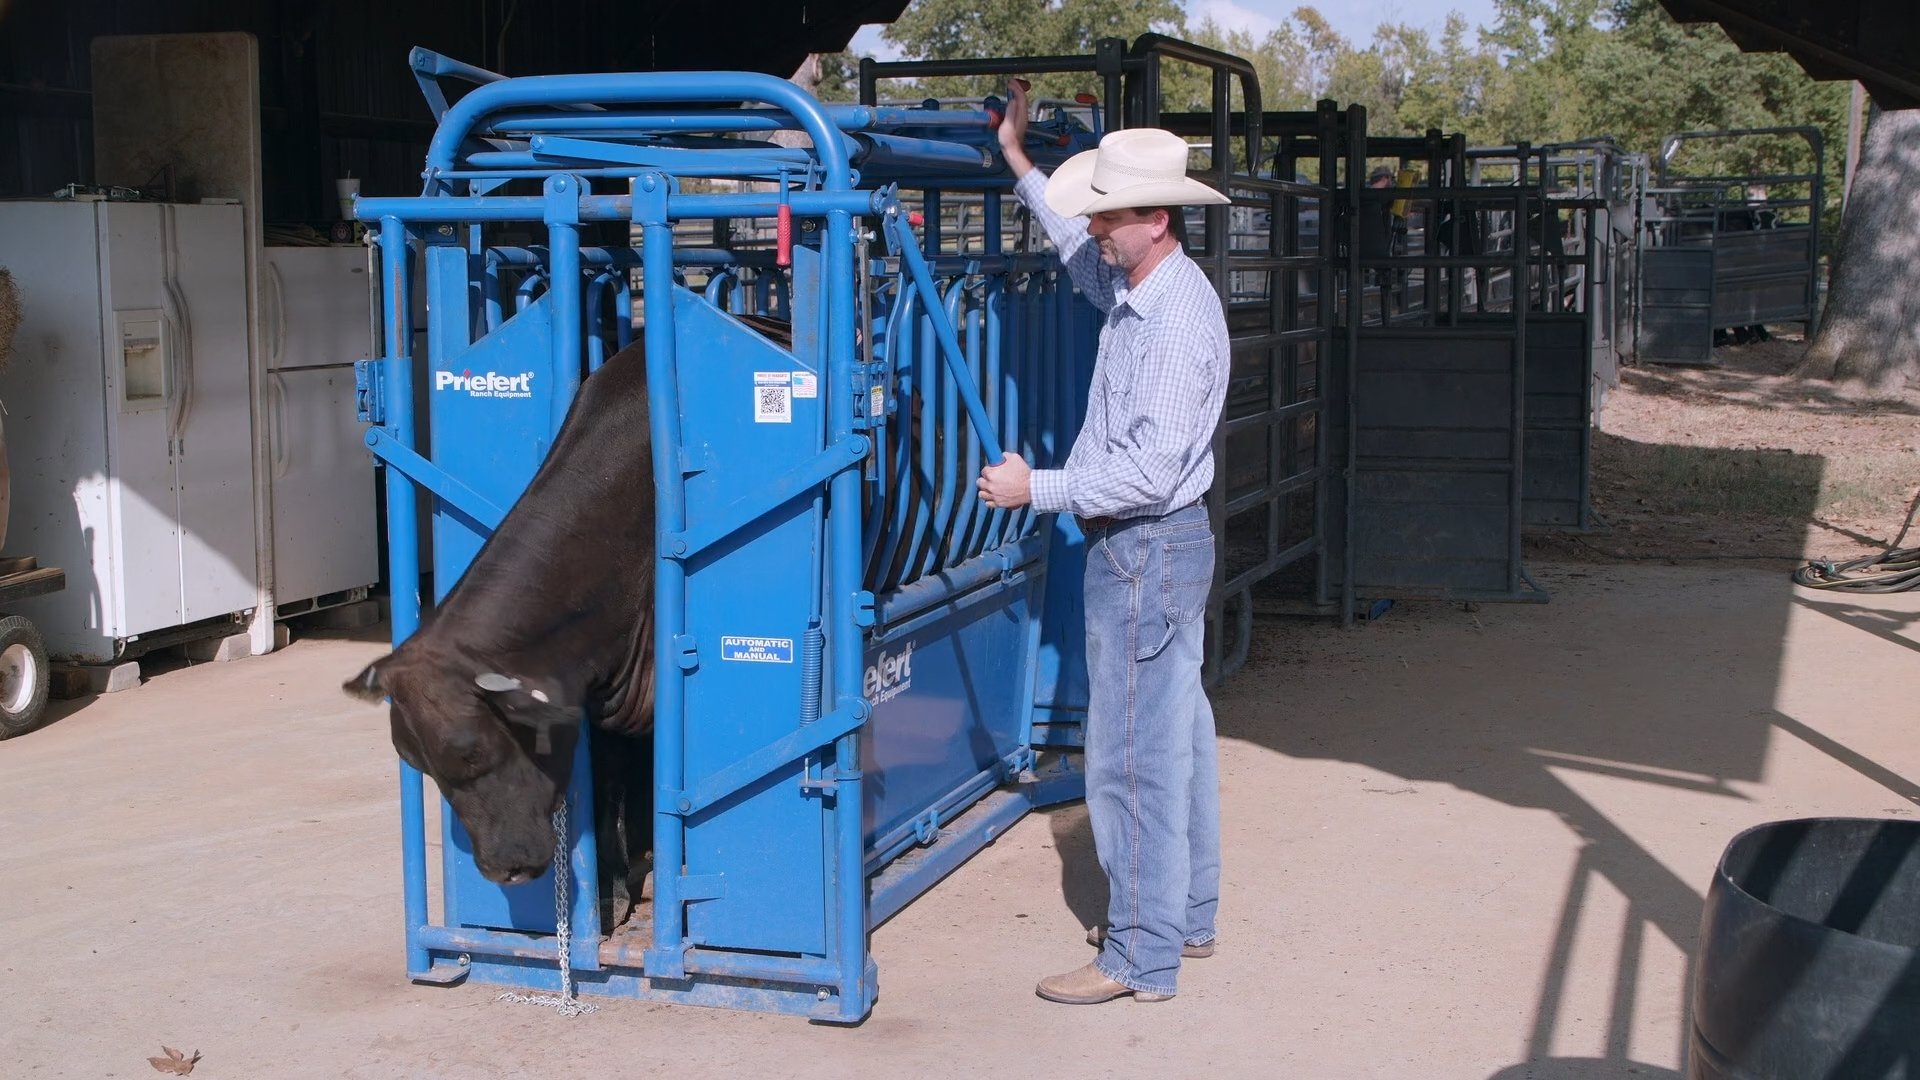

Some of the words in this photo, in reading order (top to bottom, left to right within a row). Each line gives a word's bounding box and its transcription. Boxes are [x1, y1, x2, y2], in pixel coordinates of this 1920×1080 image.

[435, 369, 530, 391] Priefert
[470, 390, 492, 398] Ranch
[494, 390, 531, 399] Equipment
[725, 638, 789, 648] AUTOMATIC
[734, 651, 780, 661] MANUAL
[863, 641, 912, 698] efert
